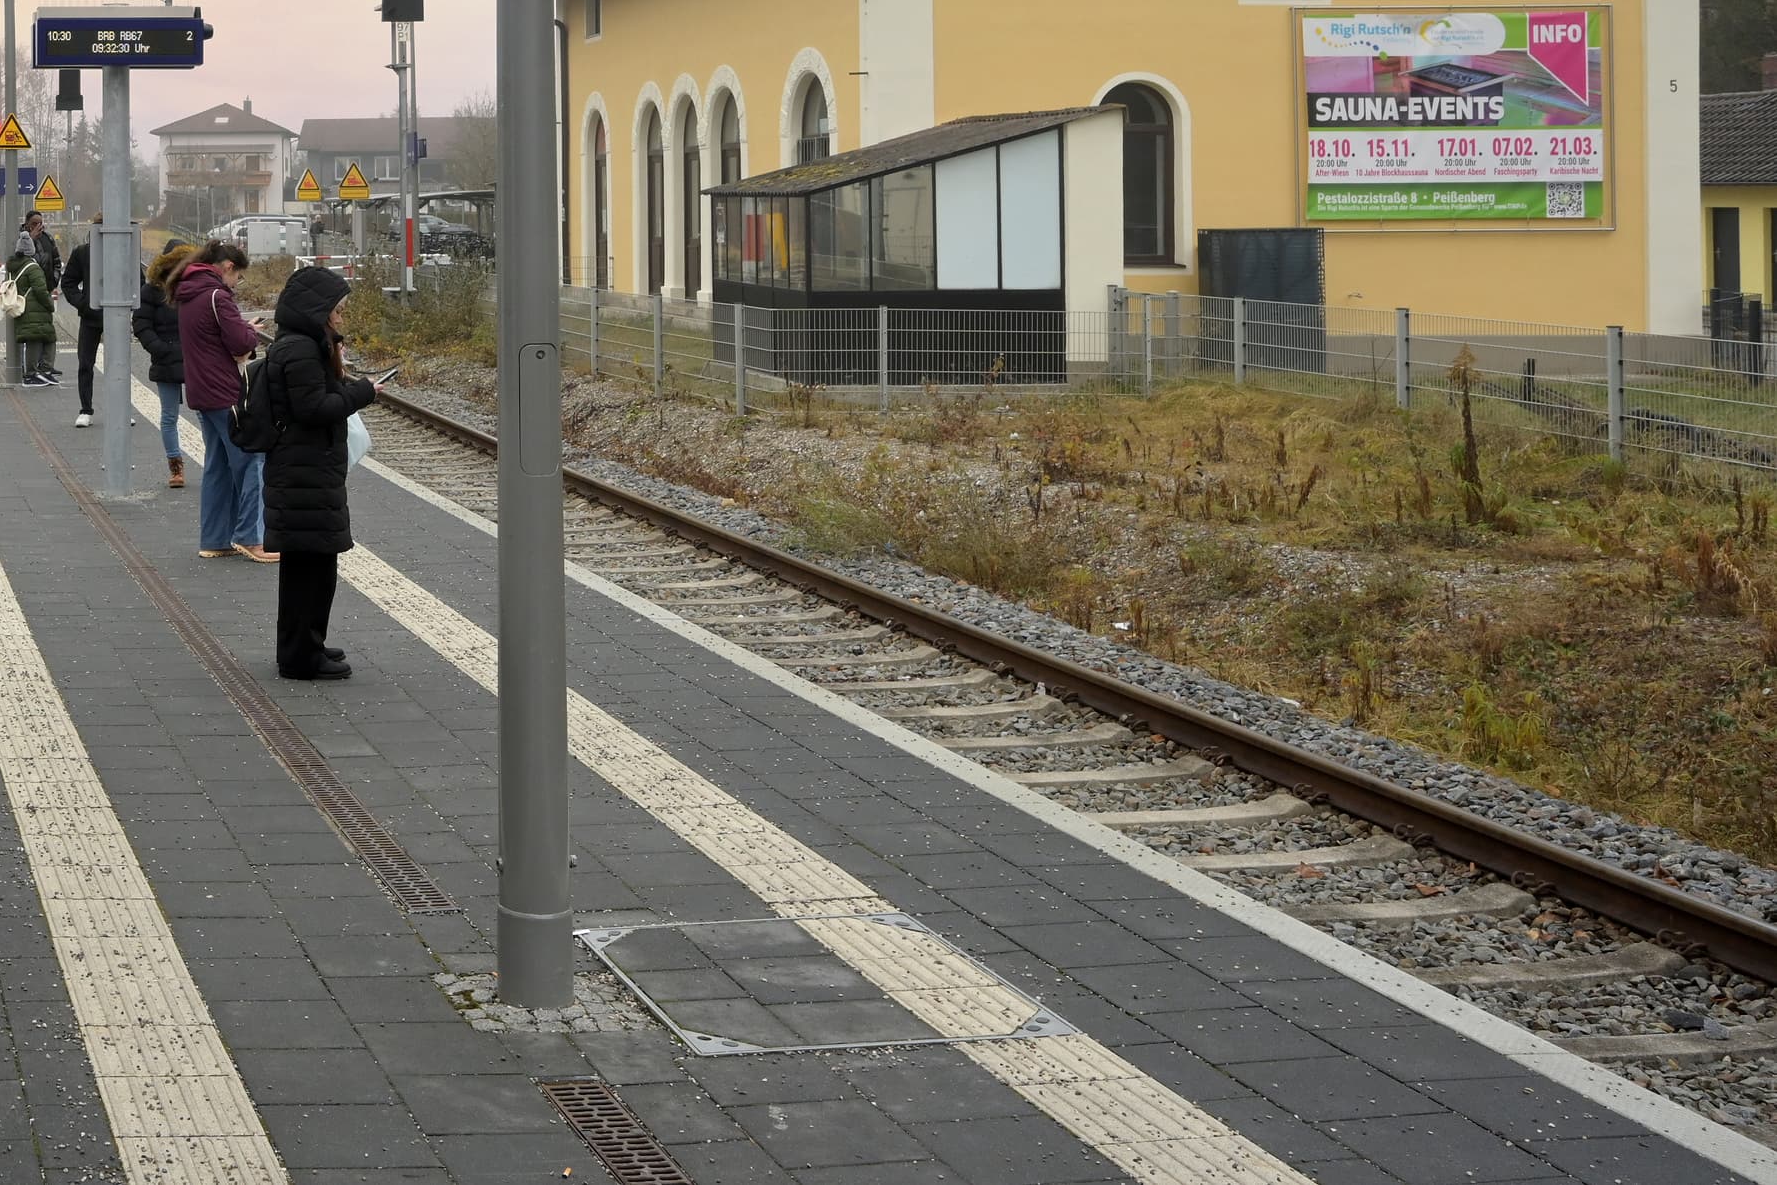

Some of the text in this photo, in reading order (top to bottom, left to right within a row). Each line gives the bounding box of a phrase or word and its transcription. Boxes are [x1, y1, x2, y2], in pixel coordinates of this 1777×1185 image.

[1331, 22, 1411, 38] Rigi Rutsch'n
[1533, 23, 1582, 44] INFO
[47, 31, 193, 41] 10:30 BRB RB67 2
[92, 43, 150, 54] 09:32:30 Uhr
[1669, 79, 1678, 93] 5
[1315, 95, 1505, 121] SAUNA-EVENTS
[1310, 136, 1597, 158] 18.10. 15.11. 17.01. 07.02. 21.03.
[1316, 159, 1348, 167] 20:00 Uhr
[1375, 159, 1407, 167] 20:00 Uhr
[1499, 158, 1519, 166] 20:00
[1558, 157, 1590, 165] 20:00 Uhr
[1493, 167, 1538, 176] Faschingsparty
[1549, 167, 1598, 175] Karibische Nacht
[1317, 192, 1408, 204] Pestalozzistraße
[1410, 192, 1418, 203] 8
[1433, 191, 1495, 206] Peißenberg
